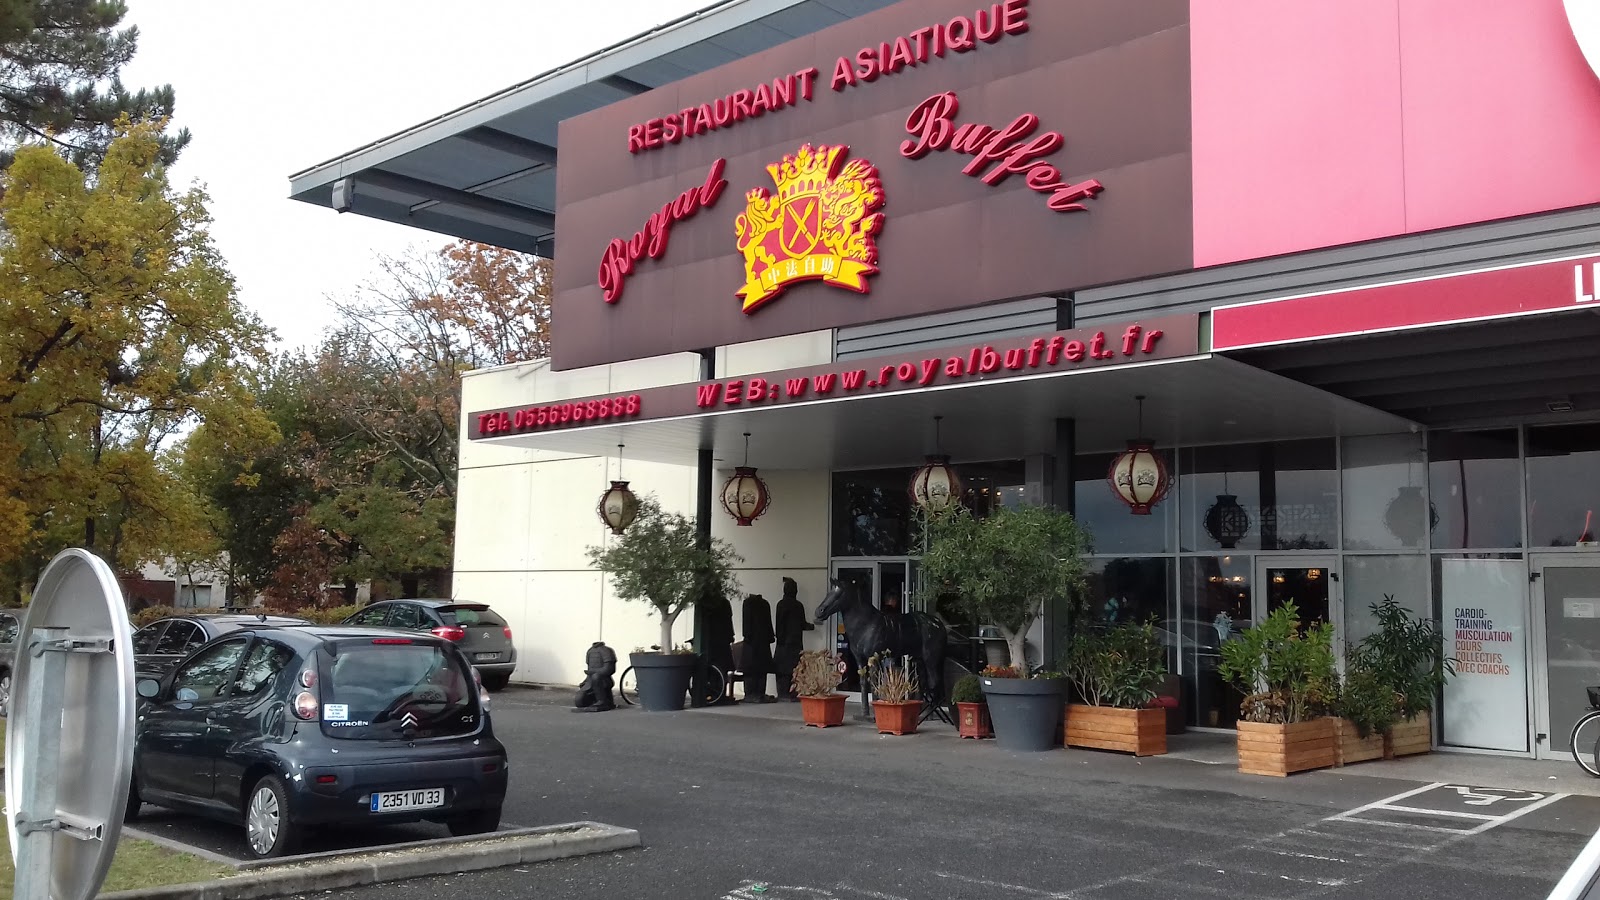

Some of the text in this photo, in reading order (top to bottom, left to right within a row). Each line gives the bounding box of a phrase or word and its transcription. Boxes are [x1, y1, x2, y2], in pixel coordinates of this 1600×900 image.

[628, 0, 1029, 154] RESTAURANT ASIATIQUE
[598, 91, 1104, 304] Royal Buffet
[768, 256, 835, 284] 中法自助
[1455, 608, 1487, 618] CARDIO-
[1455, 619, 1492, 630] TRAINING
[1455, 630, 1512, 642] MUSCULATION
[1455, 641, 1482, 652] COURS
[1455, 652, 1502, 664] COLLECTIFS
[1455, 663, 1510, 675] AVEC COACHS
[383, 793, 409, 808] 2351
[426, 790, 440, 804] 33
